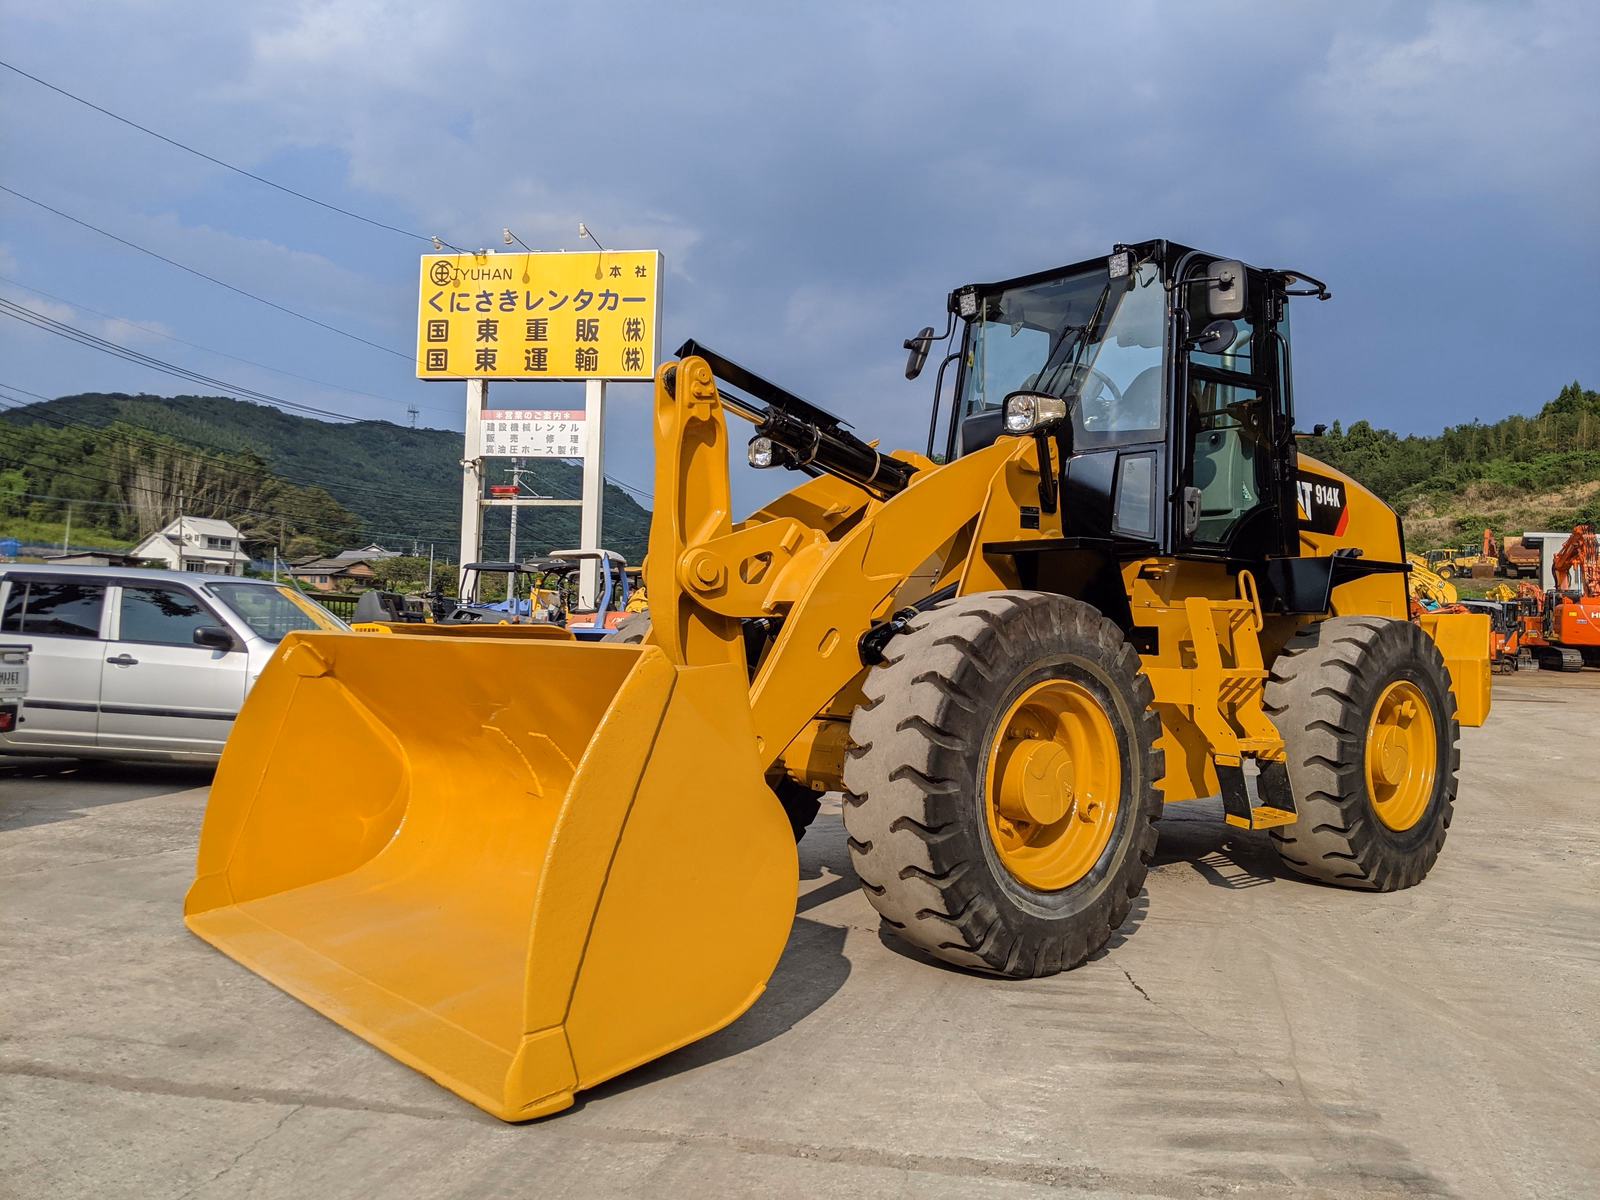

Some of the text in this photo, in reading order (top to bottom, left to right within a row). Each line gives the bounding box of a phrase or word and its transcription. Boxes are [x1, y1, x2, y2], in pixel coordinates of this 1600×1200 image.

[449, 268, 513, 281] JYUHAN
[609, 265, 647, 278] 本社
[428, 288, 646, 313] くにさきレンタカー
[486, 422, 580, 432] 建設機械レンタル
[485, 445, 579, 455] 高油圧ホース製作
[1315, 484, 1341, 508] 914K
